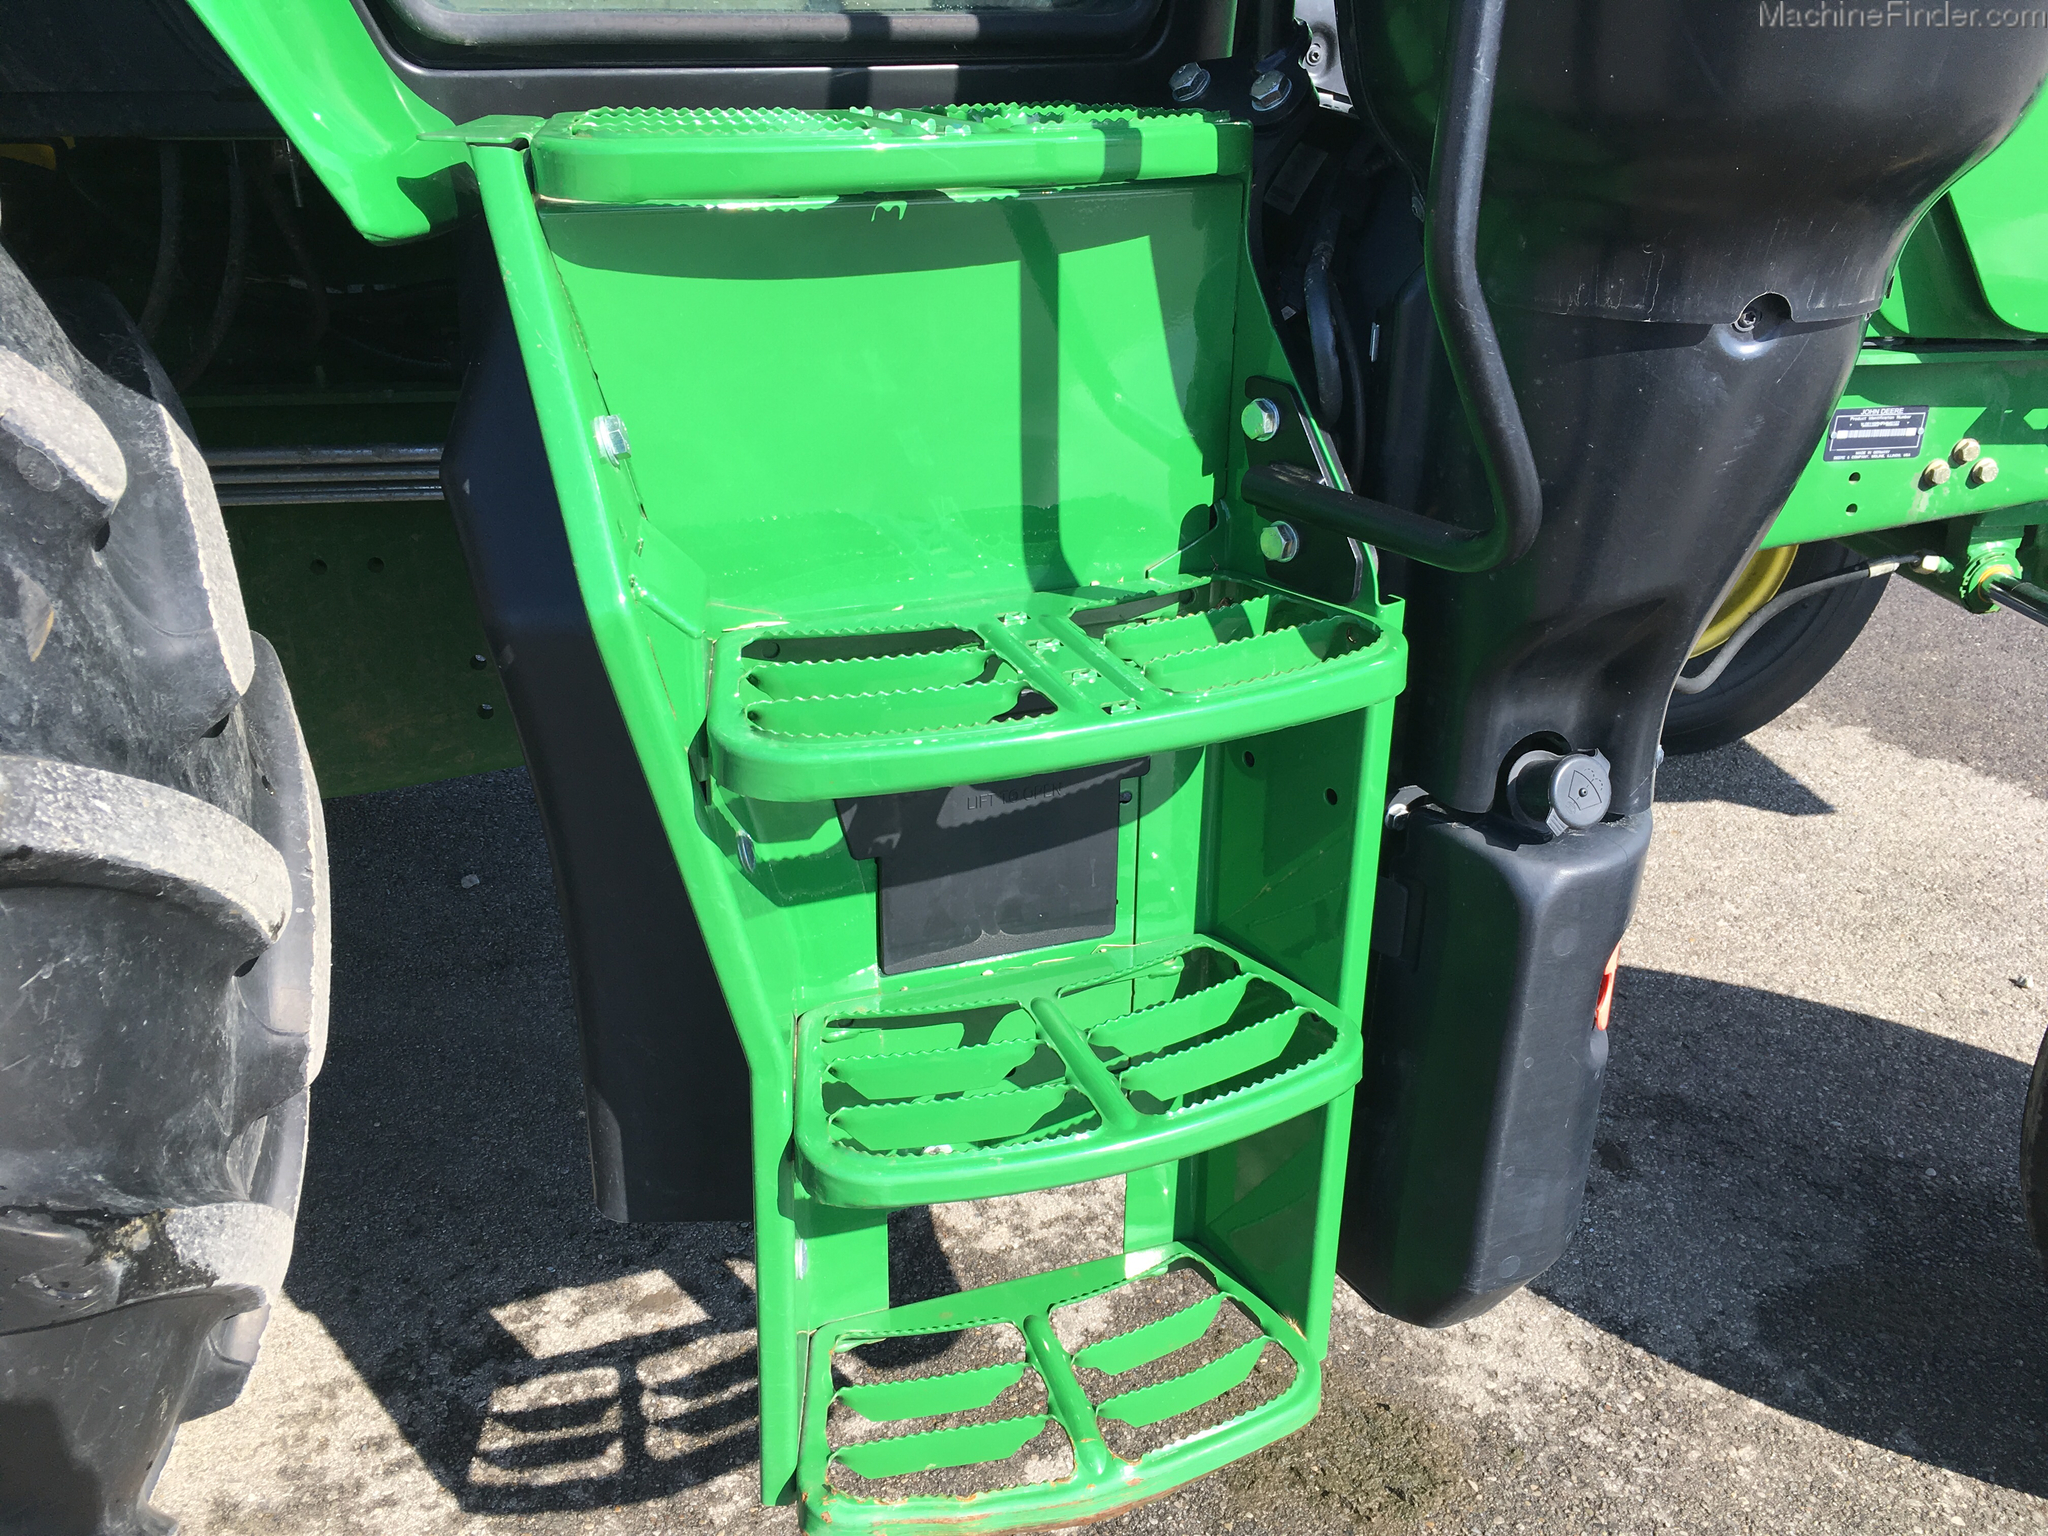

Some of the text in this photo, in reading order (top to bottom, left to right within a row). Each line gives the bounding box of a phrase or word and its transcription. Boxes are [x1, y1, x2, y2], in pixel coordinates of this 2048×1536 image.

[967, 782, 1063, 810] LIFT TO OPEN
